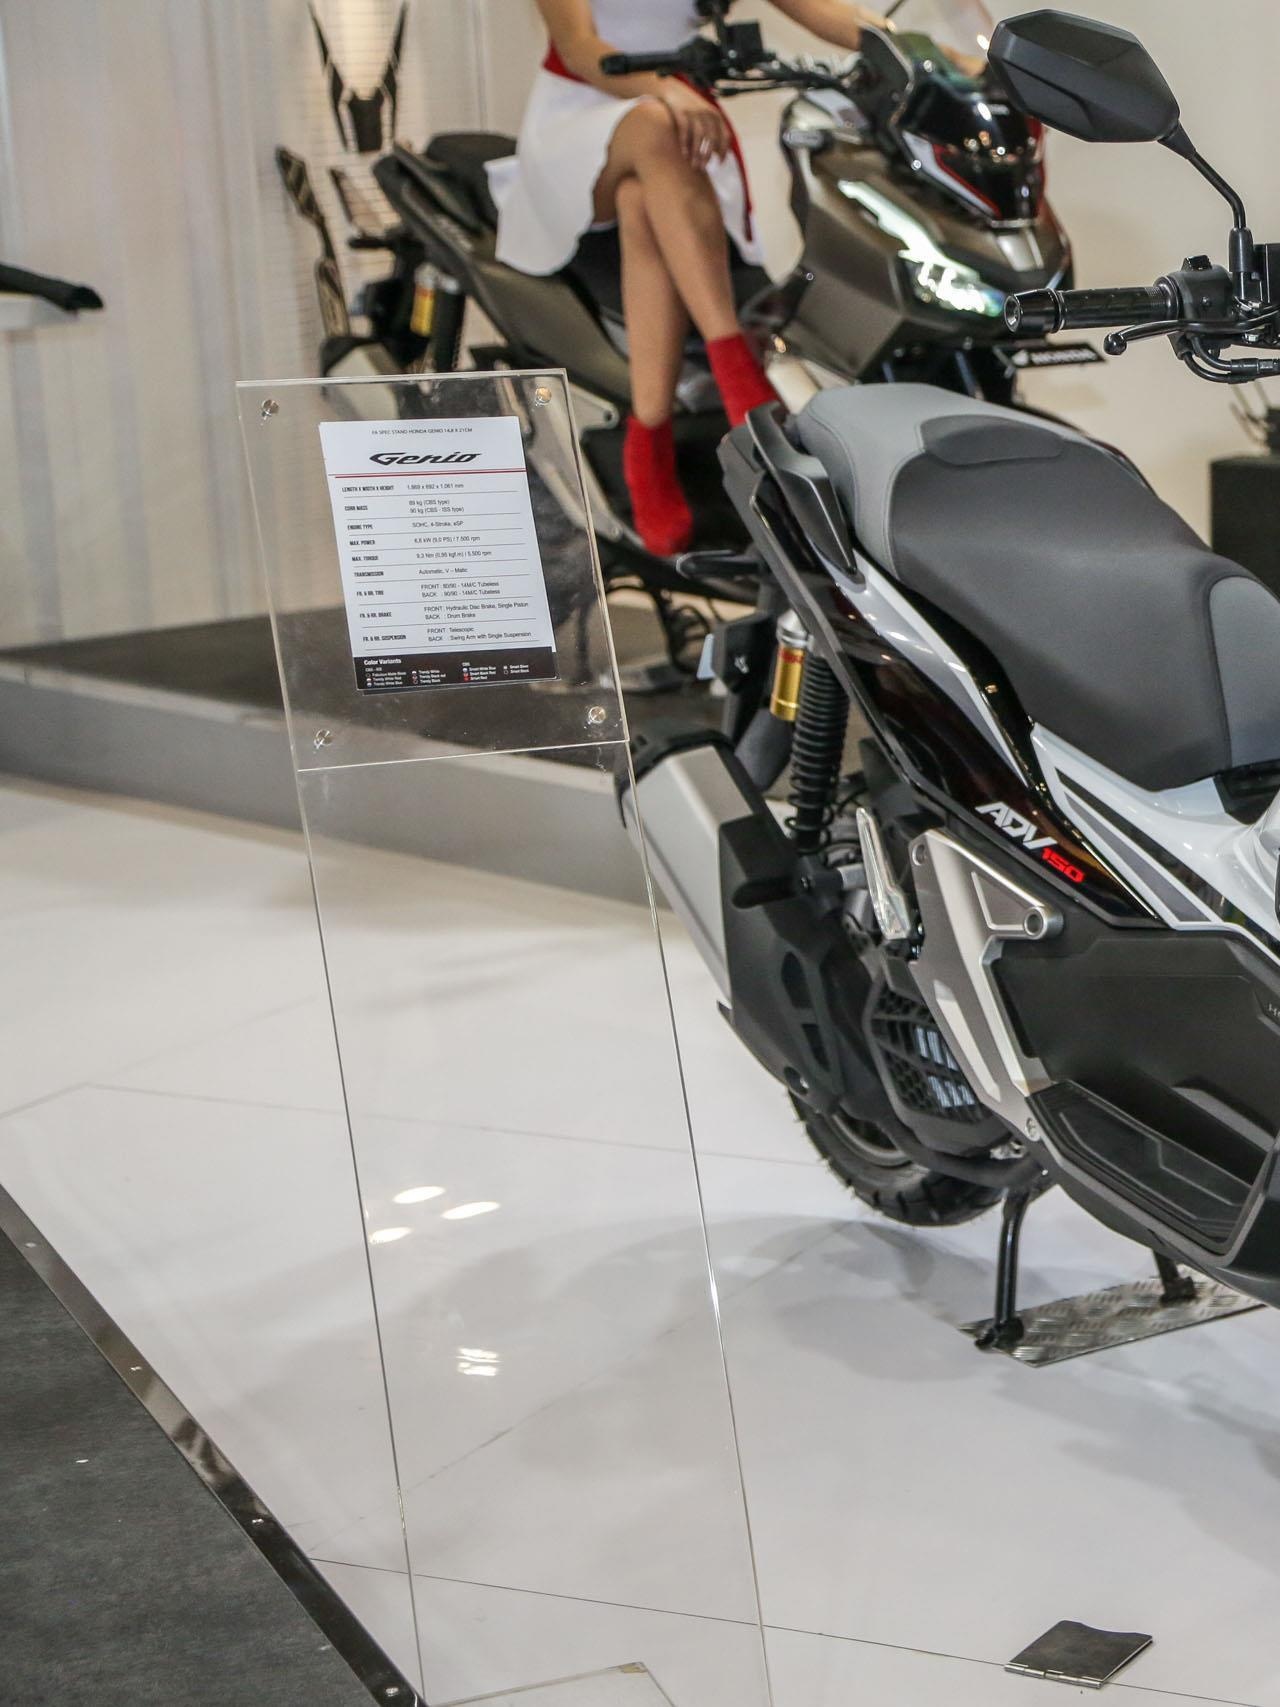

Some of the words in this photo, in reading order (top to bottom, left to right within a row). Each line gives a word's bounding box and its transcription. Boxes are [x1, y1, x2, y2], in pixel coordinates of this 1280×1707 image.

[369, 451, 482, 466] Genio
[974, 801, 1058, 850] ADV
[1042, 847, 1085, 883] 150
